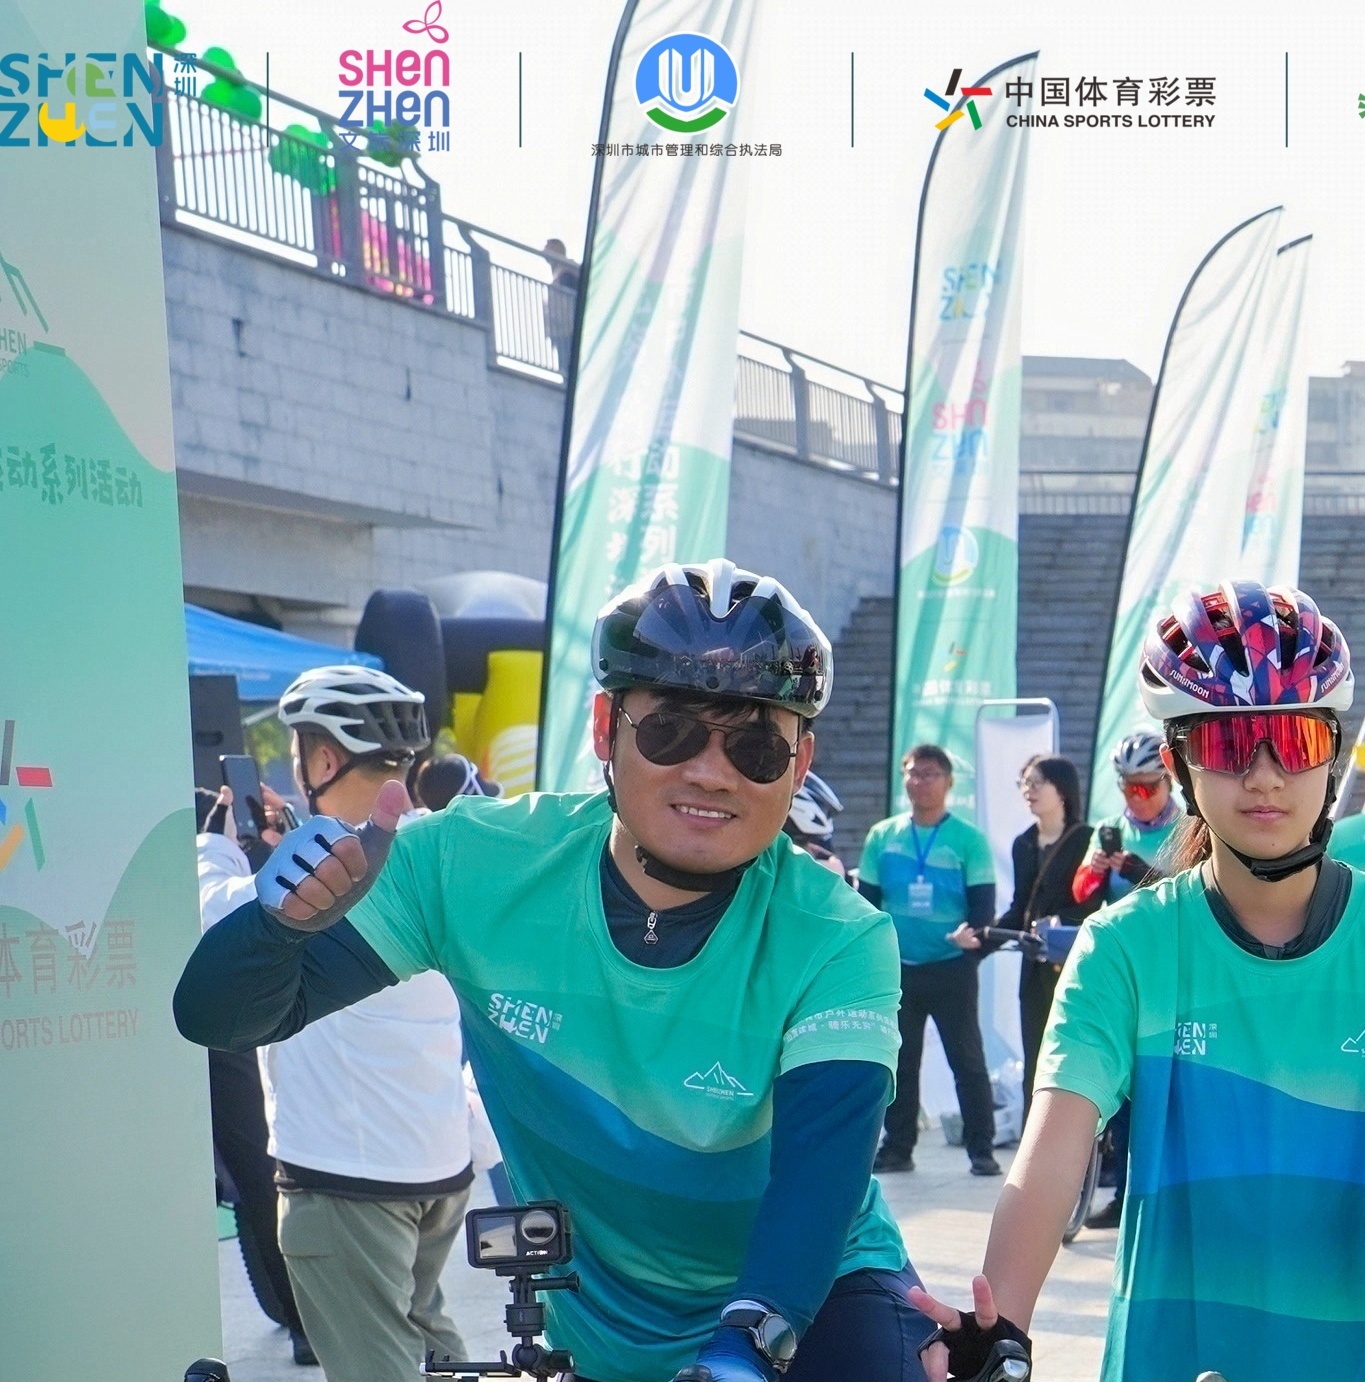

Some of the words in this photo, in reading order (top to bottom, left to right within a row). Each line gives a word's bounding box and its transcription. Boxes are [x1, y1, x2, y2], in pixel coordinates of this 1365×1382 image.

[0, 442, 144, 508] 动系列活动
[58, 1008, 140, 1046] LOTTERY
